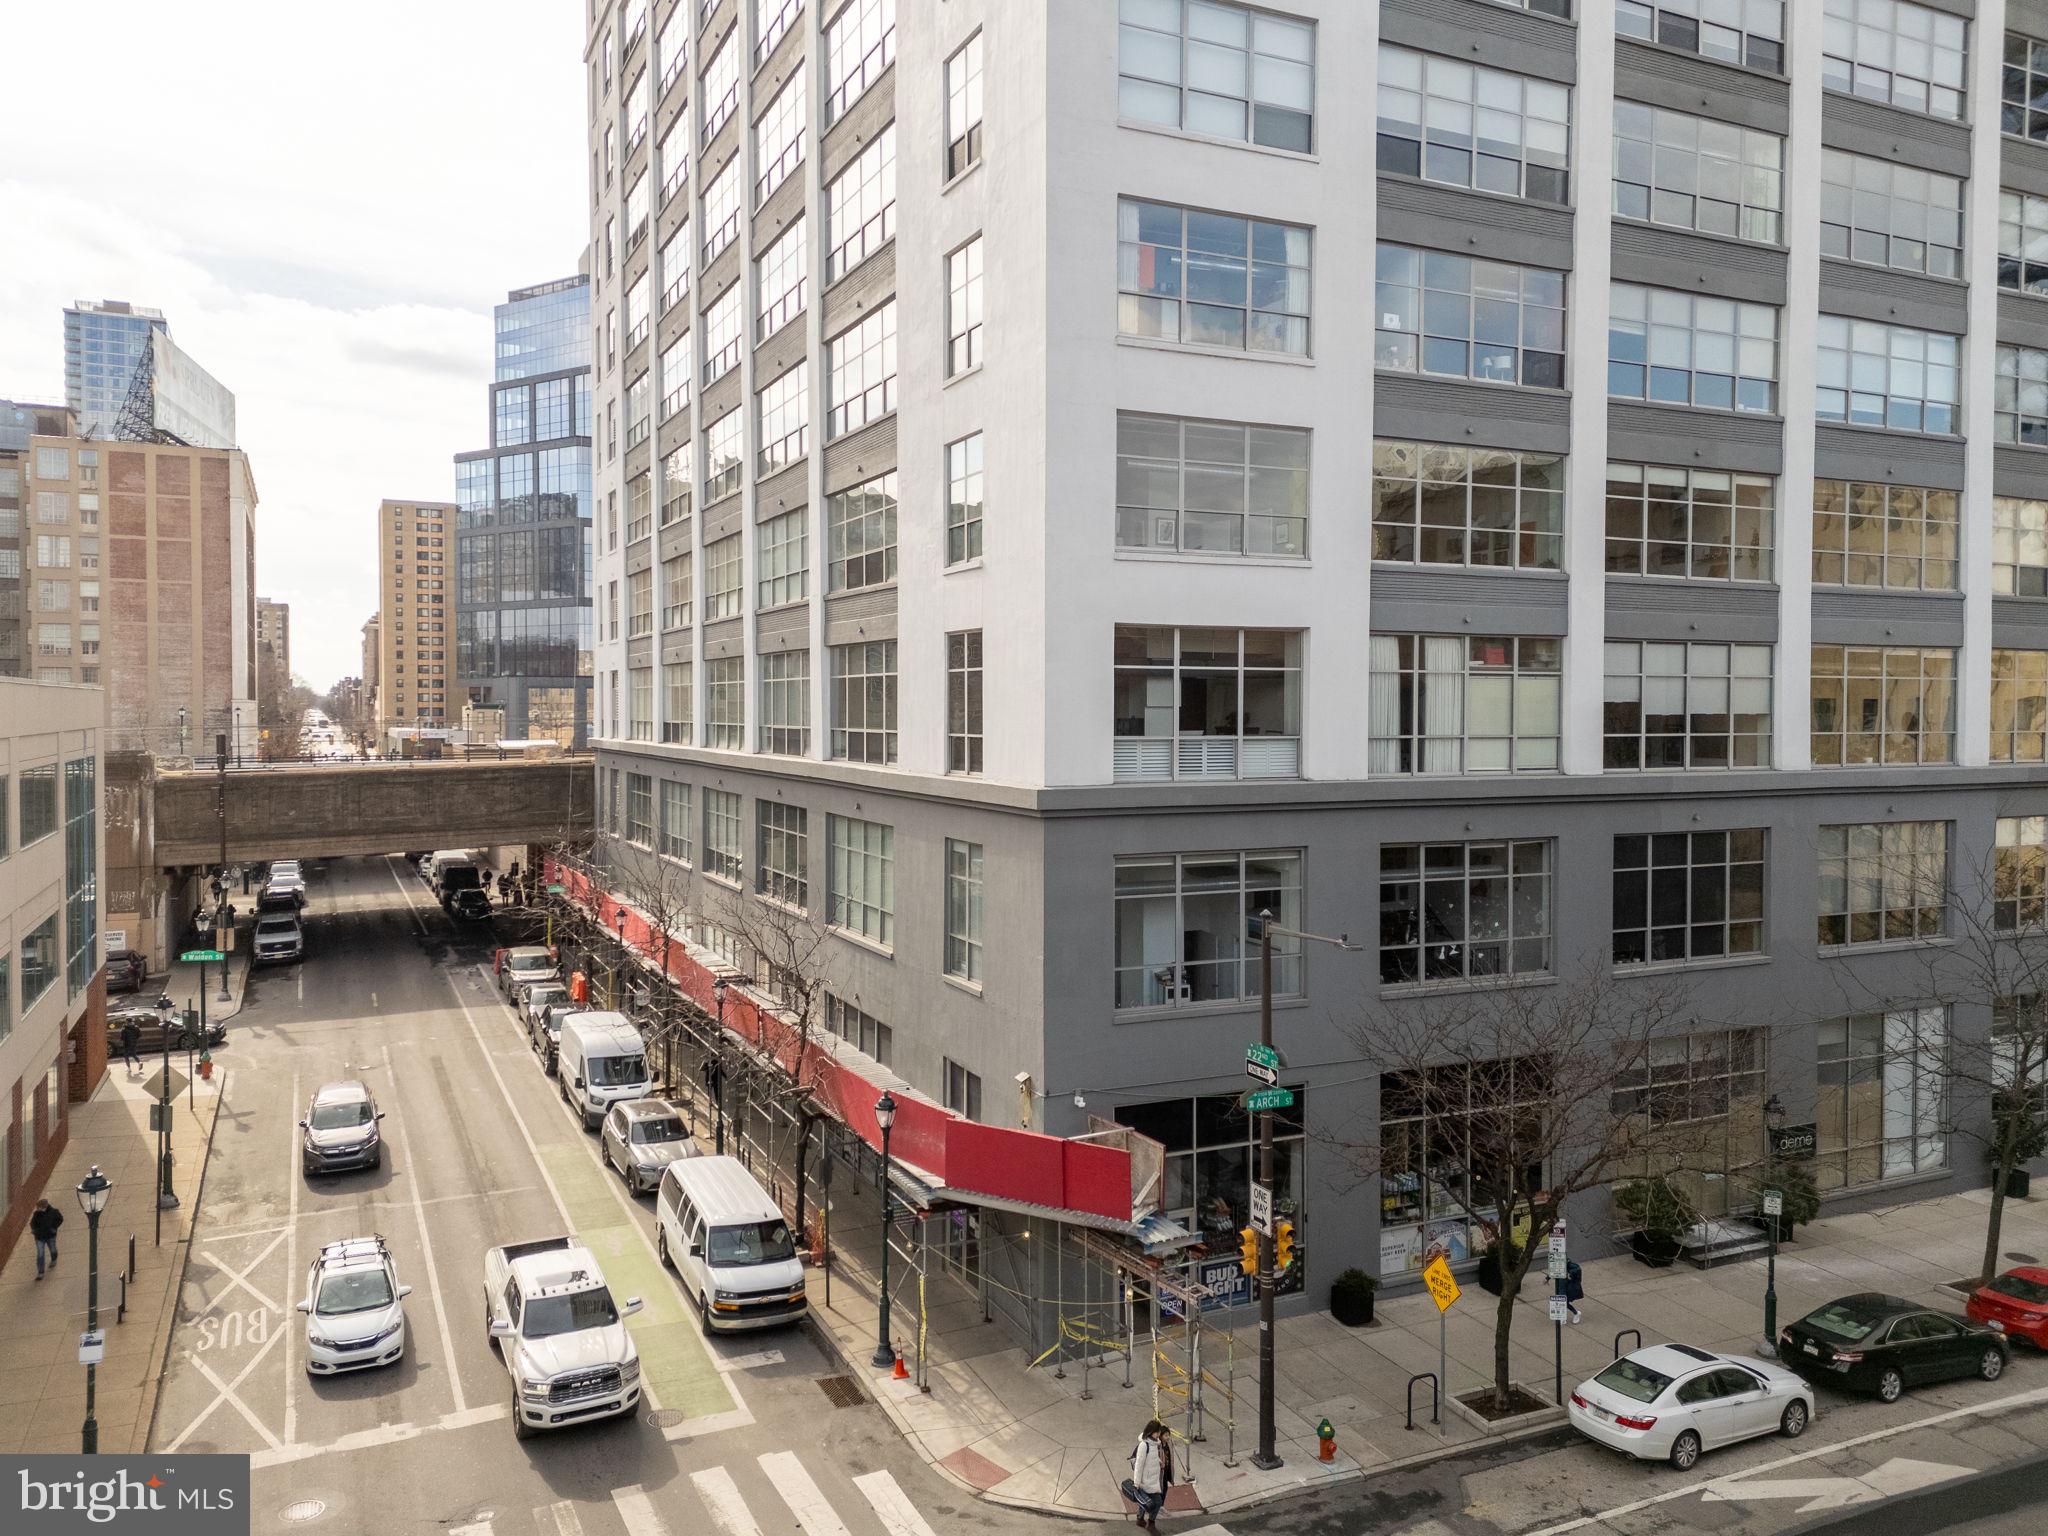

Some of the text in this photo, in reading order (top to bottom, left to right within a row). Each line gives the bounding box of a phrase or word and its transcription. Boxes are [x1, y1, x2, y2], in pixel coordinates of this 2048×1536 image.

[1270, 1059, 1279, 1070] ST
[1256, 1096, 1294, 1109] ARCH ST
[1253, 1188, 1268, 1204] ONE
[1253, 1199, 1268, 1215] WAY
[1206, 1264, 1239, 1284] BUD
[1206, 1277, 1245, 1297] IGHT
[1430, 1275, 1452, 1293] MERGE
[1432, 1286, 1451, 1303] RIGHT
[1161, 1300, 1183, 1310] OPEN
[196, 1307, 267, 1352] BUS
